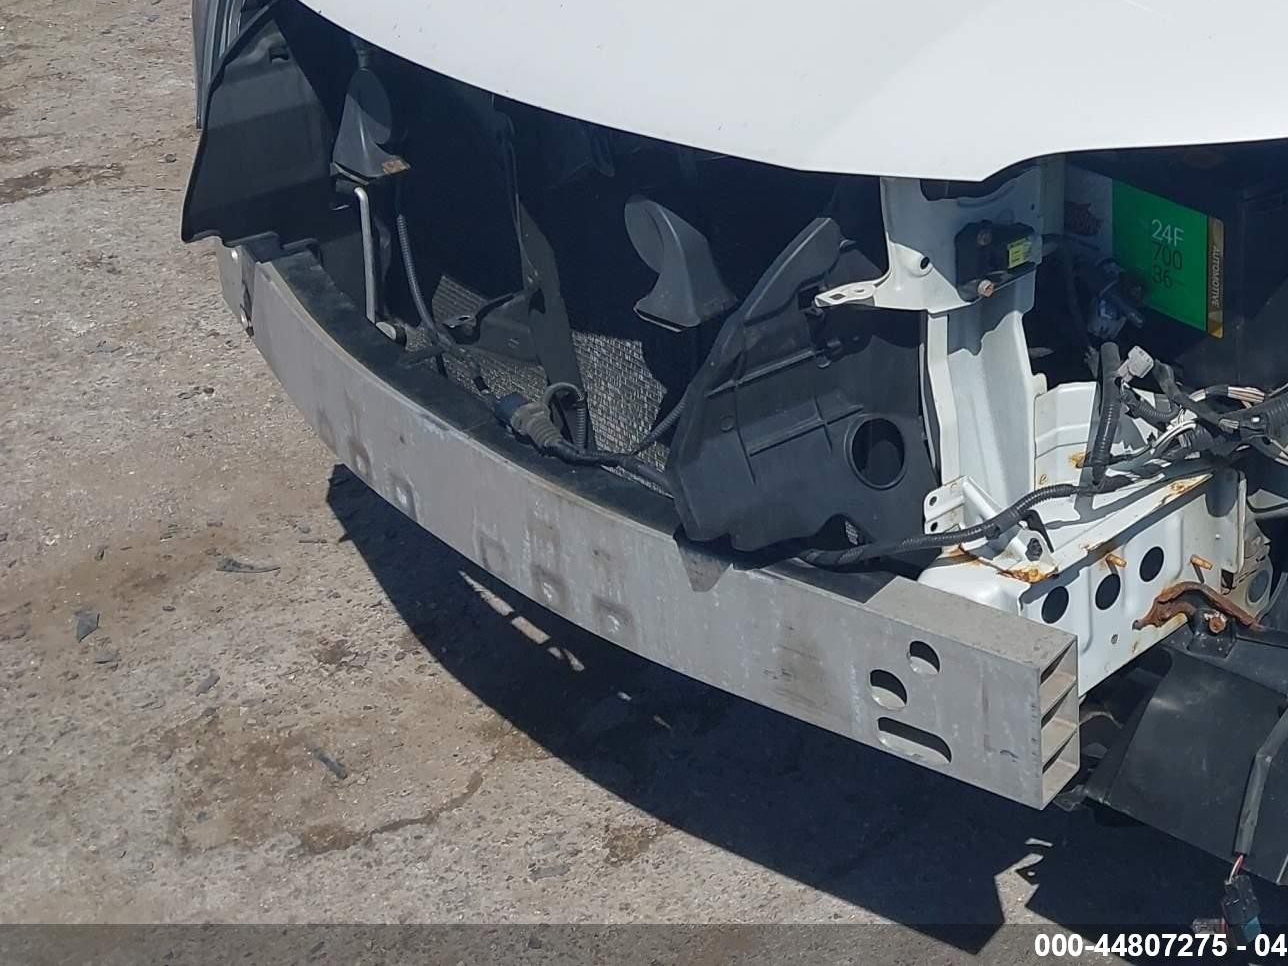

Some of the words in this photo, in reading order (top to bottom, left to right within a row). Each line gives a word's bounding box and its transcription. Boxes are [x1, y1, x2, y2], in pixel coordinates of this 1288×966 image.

[1151, 219, 1185, 247] 24F
[1152, 242, 1183, 271] 700
[1152, 265, 1174, 289] 36
[1211, 245, 1221, 309] AUTOMOTIVE
